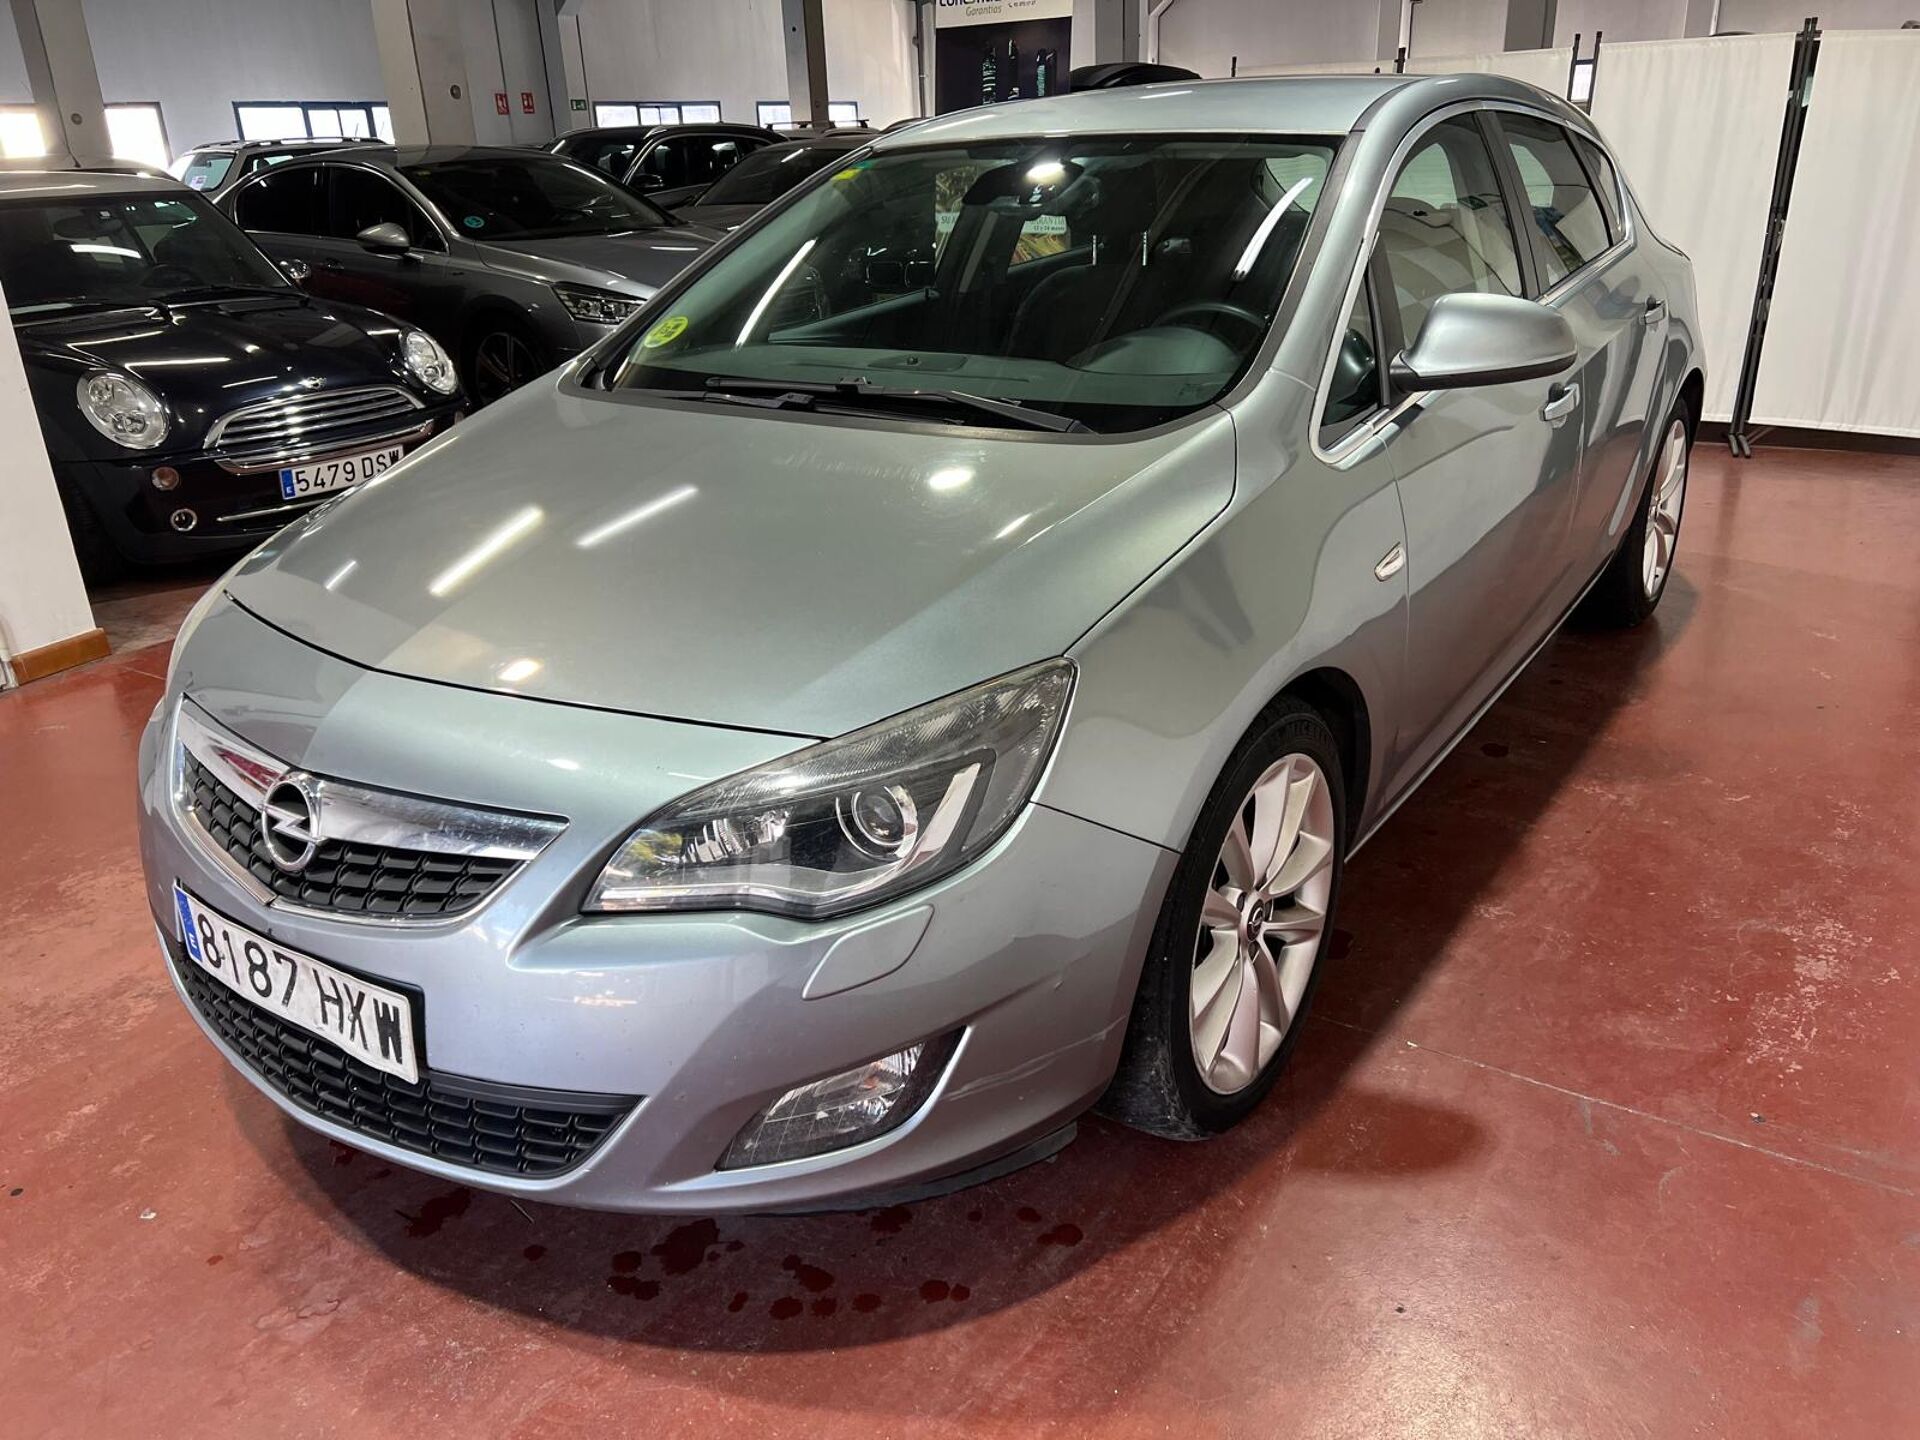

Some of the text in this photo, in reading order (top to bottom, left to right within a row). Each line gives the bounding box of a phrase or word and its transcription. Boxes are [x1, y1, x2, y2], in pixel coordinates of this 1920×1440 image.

[295, 449, 399, 492] 5479 DSW
[197, 912, 403, 1065] 8187 HXW
